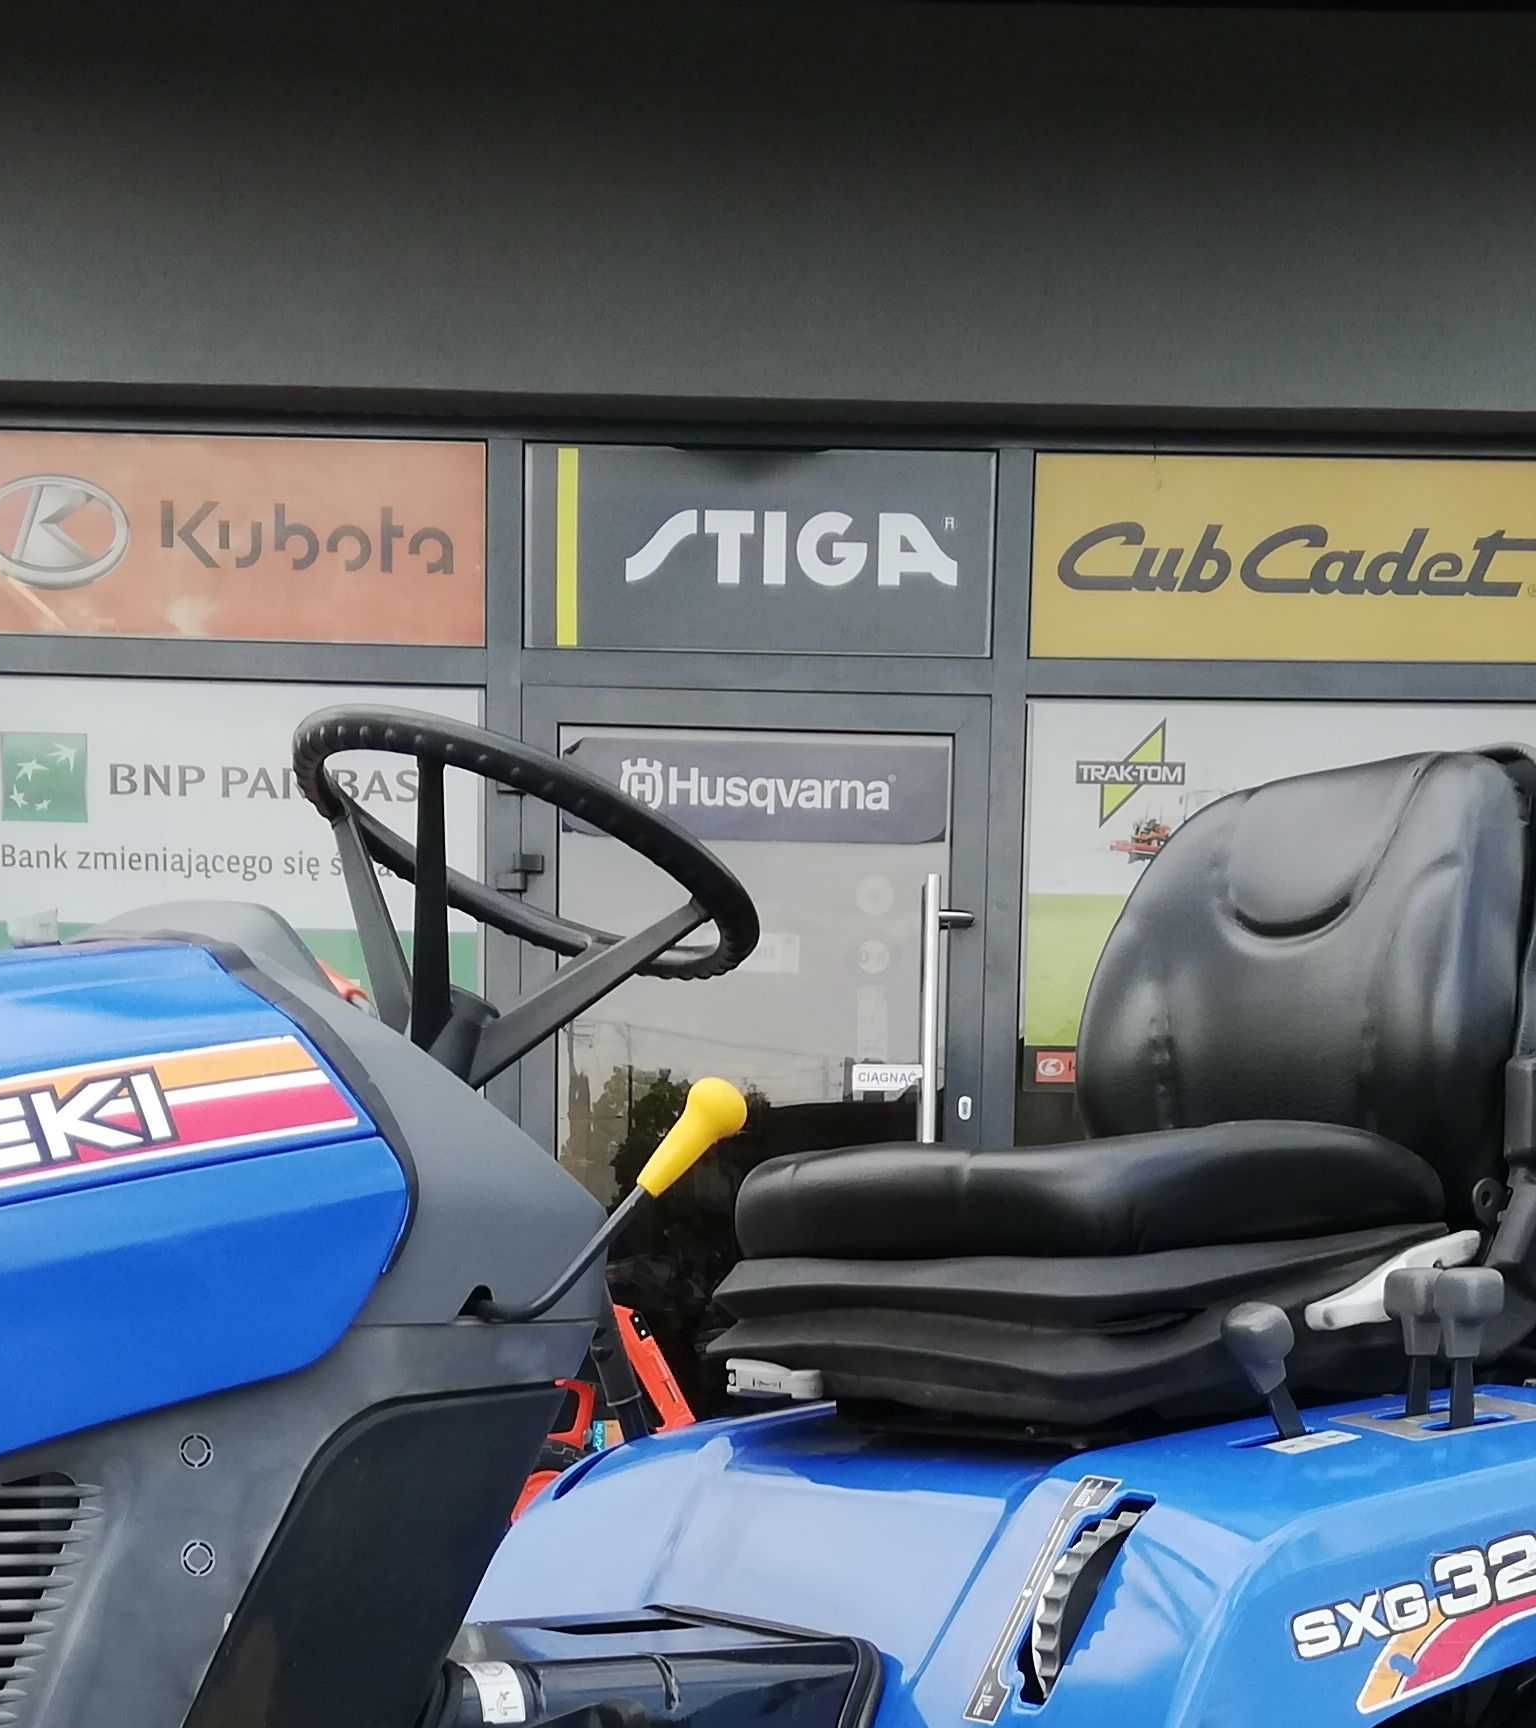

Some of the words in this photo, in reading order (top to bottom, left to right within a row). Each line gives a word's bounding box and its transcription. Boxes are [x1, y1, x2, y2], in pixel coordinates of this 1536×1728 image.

[160, 499, 455, 575] Kubota
[624, 508, 959, 588] STIGA
[1056, 520, 1232, 594] Cub
[107, 762, 207, 798] BNP
[667, 766, 891, 815] Husqvarna
[1078, 763, 1183, 784] TRAK-TOM
[0, 843, 69, 870] Bank
[76, 846, 274, 882] zmieniającego
[282, 849, 321, 881] się
[1291, 1581, 1428, 1659] SXG
